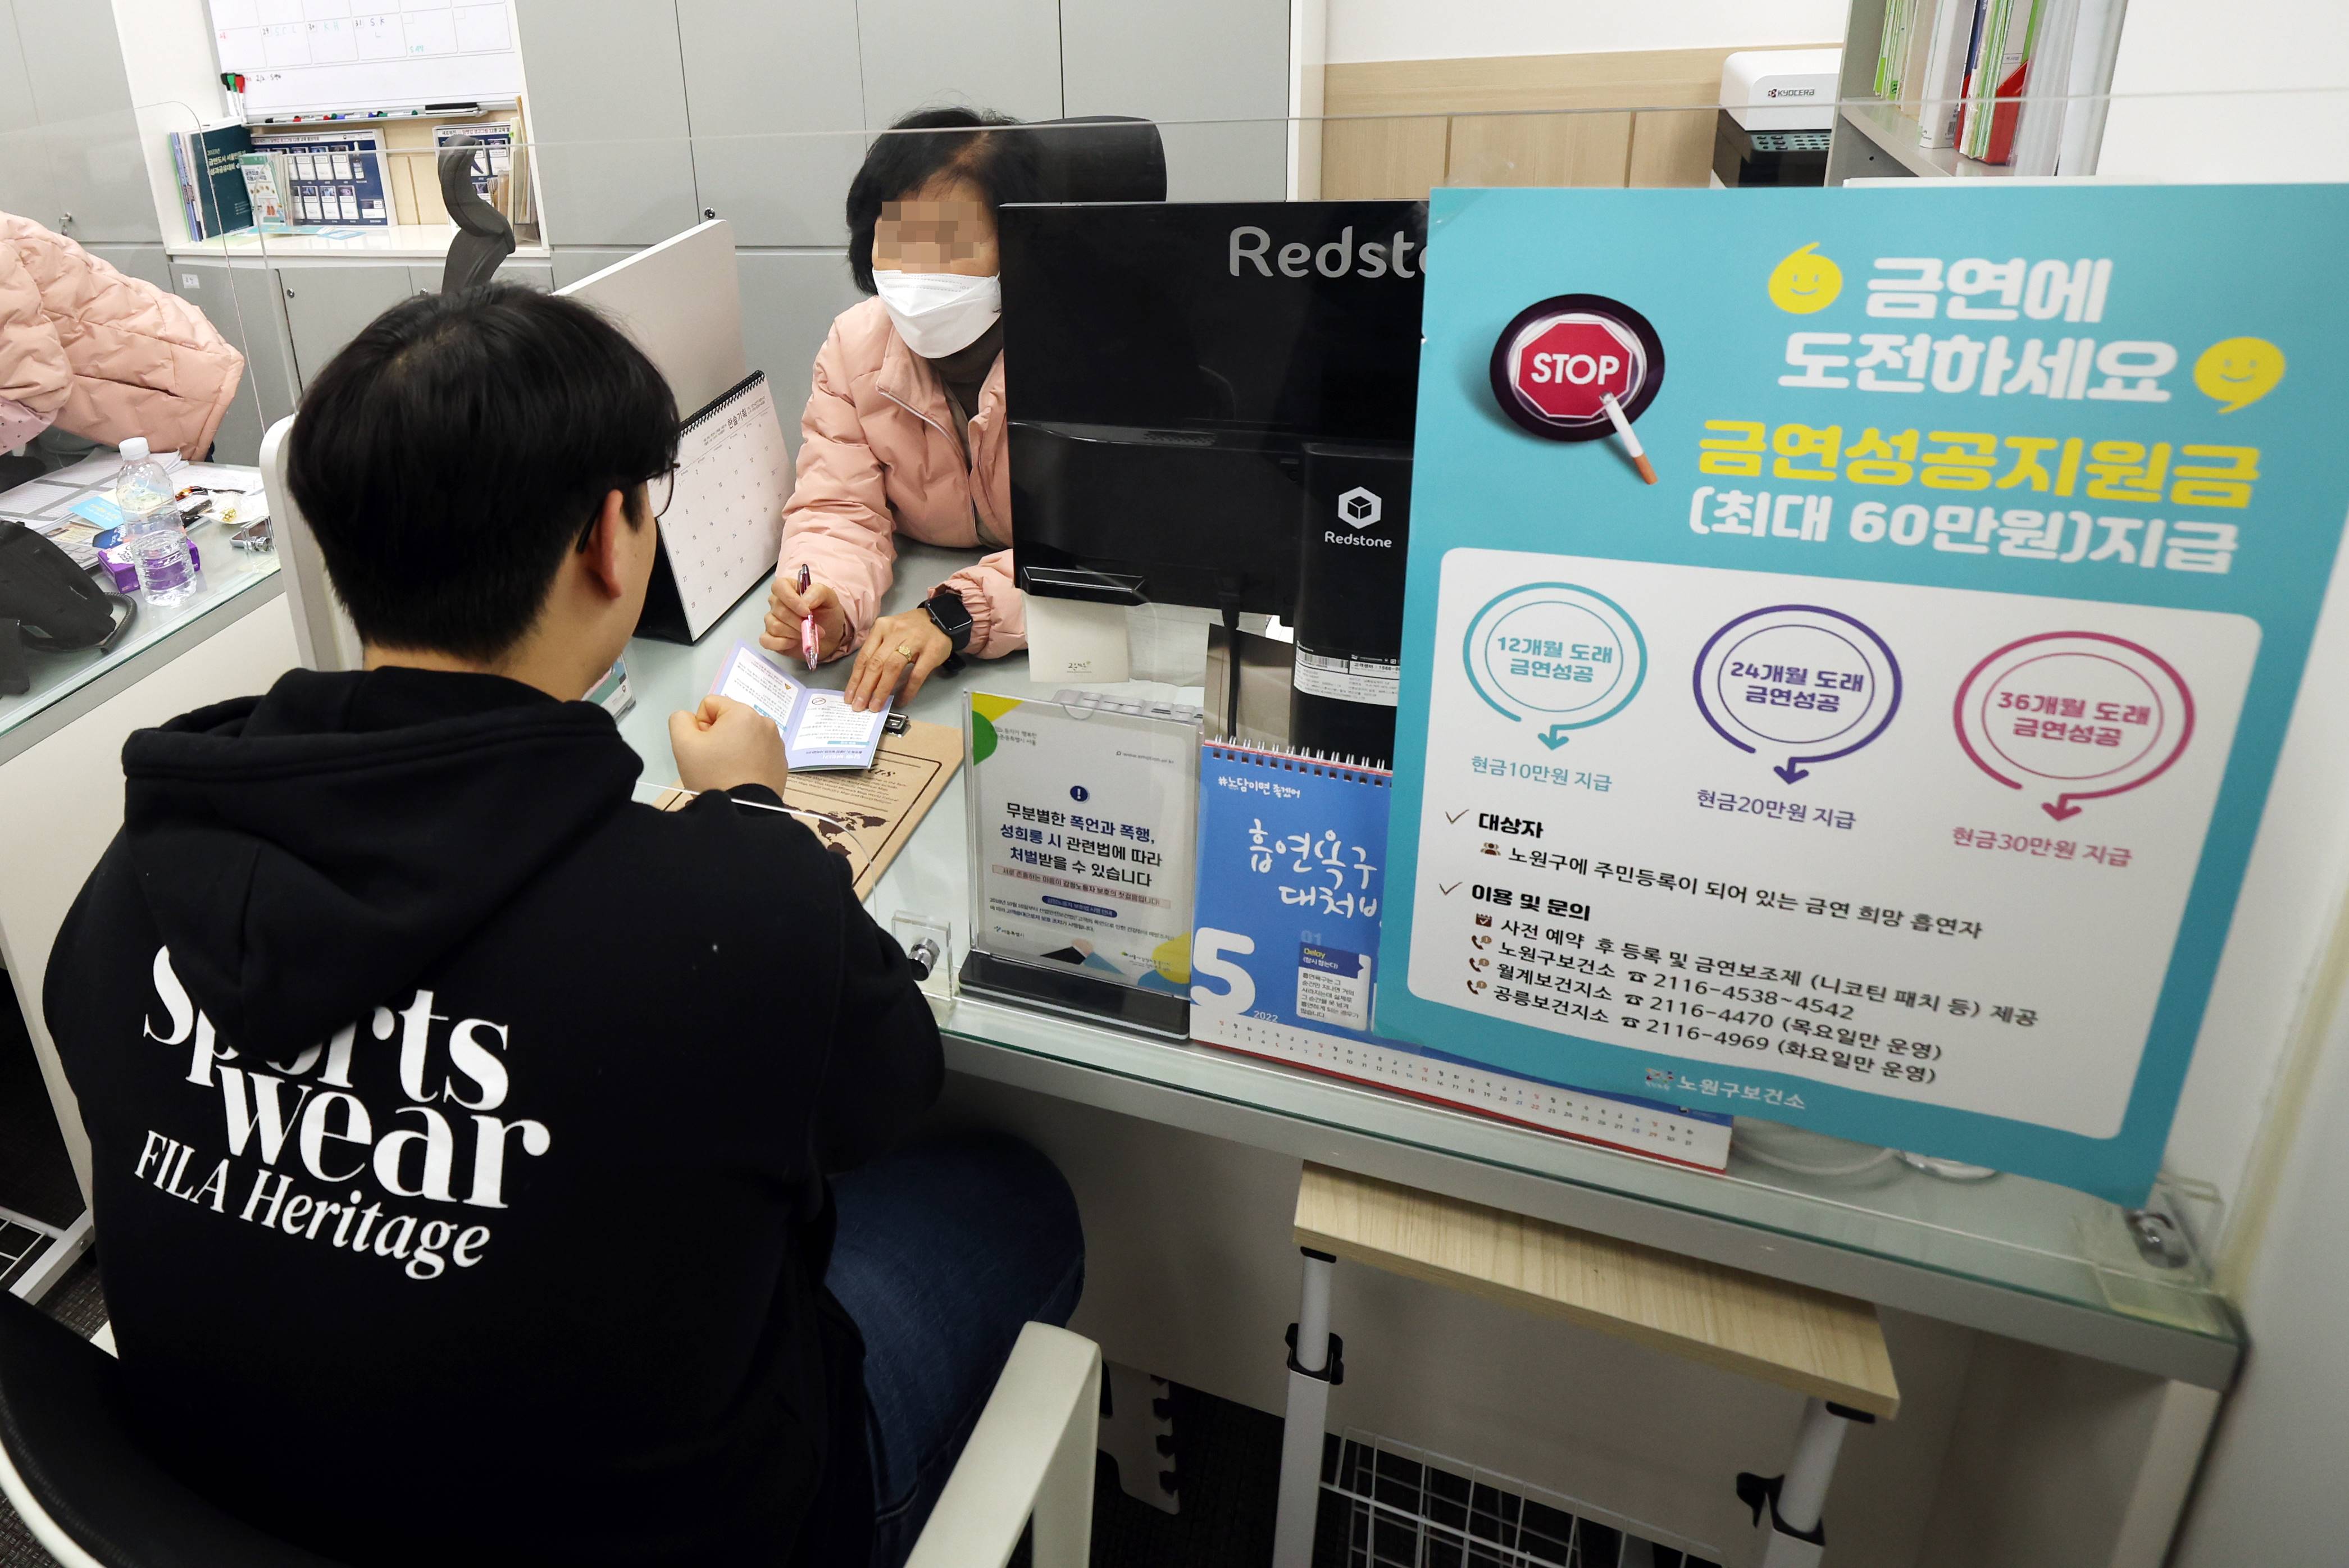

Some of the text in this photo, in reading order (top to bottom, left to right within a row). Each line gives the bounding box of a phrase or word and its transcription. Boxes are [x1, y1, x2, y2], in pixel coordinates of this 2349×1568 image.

[1867, 257, 2113, 323] 금연에
[1531, 352, 1620, 385] STOP
[1778, 332, 2178, 402] 도전하세요
[1699, 419, 2260, 508] 금연성공지원금
[1324, 530, 1392, 549] Redstone
[1688, 486, 2238, 575] (최대 60만원)지급
[1497, 637, 1613, 664] 12개월 도래
[1510, 658, 1594, 683] 금연성공
[1730, 662, 1864, 694] 24개월 도래
[1745, 685, 1841, 713] 금연성공
[1997, 692, 2150, 726] 36개월 도래
[2013, 717, 2123, 747] 금연성공
[1471, 755, 1612, 792] 현금10만원 지급
[1007, 802, 1155, 844] 무분별한 폭언과 폭행,
[1478, 813, 1544, 838] 대상자
[1696, 788, 1856, 831] 현금20만원 지급
[1000, 824, 1162, 867] 성희롱 시 관련법에 따라
[1249, 818, 1377, 890] 흡연욕구
[1951, 826, 2132, 867] 현금30만원 지급
[1010, 847, 1152, 887] 처벌받을 수 있습니다
[1472, 883, 1591, 922] 이용 및 문의
[1508, 847, 1983, 940] 노원구에 주민등록이 되어 있는 금연 희망 흡연자
[1190, 927, 1256, 1015] 5
[1304, 947, 1326, 959] Delay
[1500, 919, 2038, 1028] 사전 예약 후 등록 및 금연보조제 (니코틴 패치 등) 제공
[1498, 941, 1854, 1020] 노원구보건소 2116-4538~4542
[143, 945, 509, 1110] Sprts
[1253, 1010, 1278, 1023] 2022
[1496, 962, 1942, 1061] 월계보건지소 2116-4470 (목요일만 운영)
[1493, 985, 1936, 1084] 공릉보건지소 2116-4969 (화요일만 운영)
[1677, 1075, 1805, 1109] 노원구보건소
[134, 1130, 490, 1280] FILA Heritage
